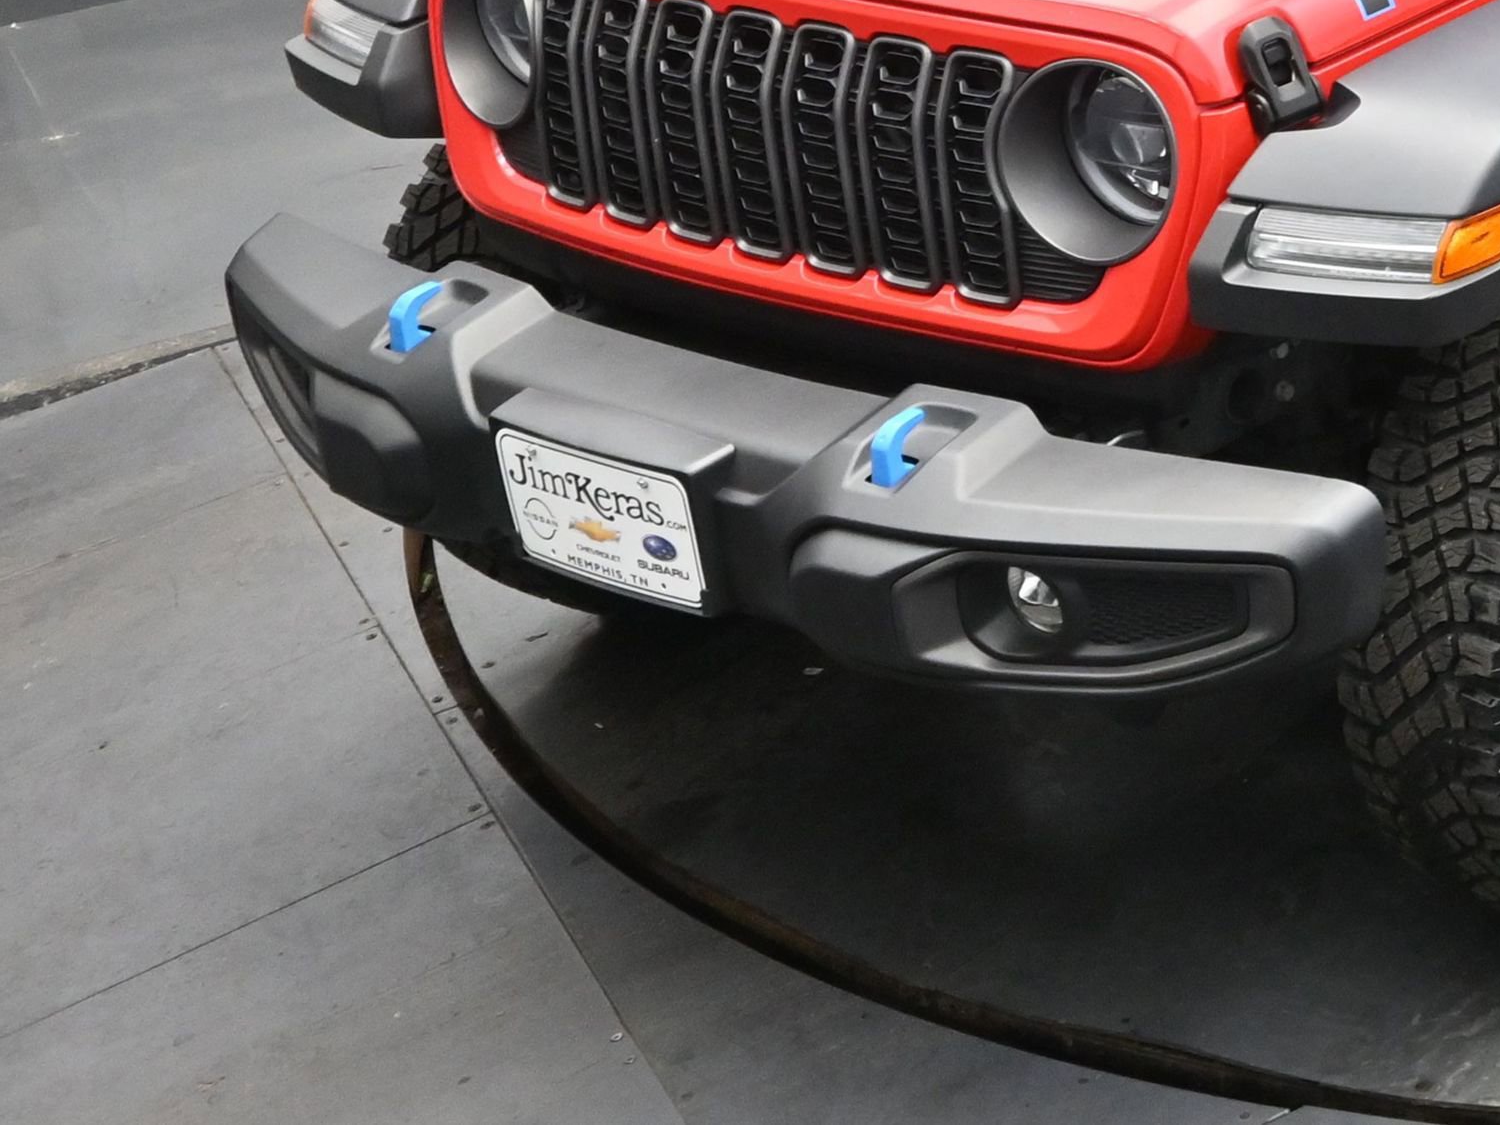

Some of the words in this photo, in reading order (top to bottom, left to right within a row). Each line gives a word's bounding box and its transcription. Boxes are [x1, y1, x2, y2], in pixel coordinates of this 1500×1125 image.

[576, 543, 621, 562] CHEVROLET
[567, 554, 626, 584] MEMPHIS,
[630, 574, 649, 587] TN
[637, 559, 690, 581] SUBARU
